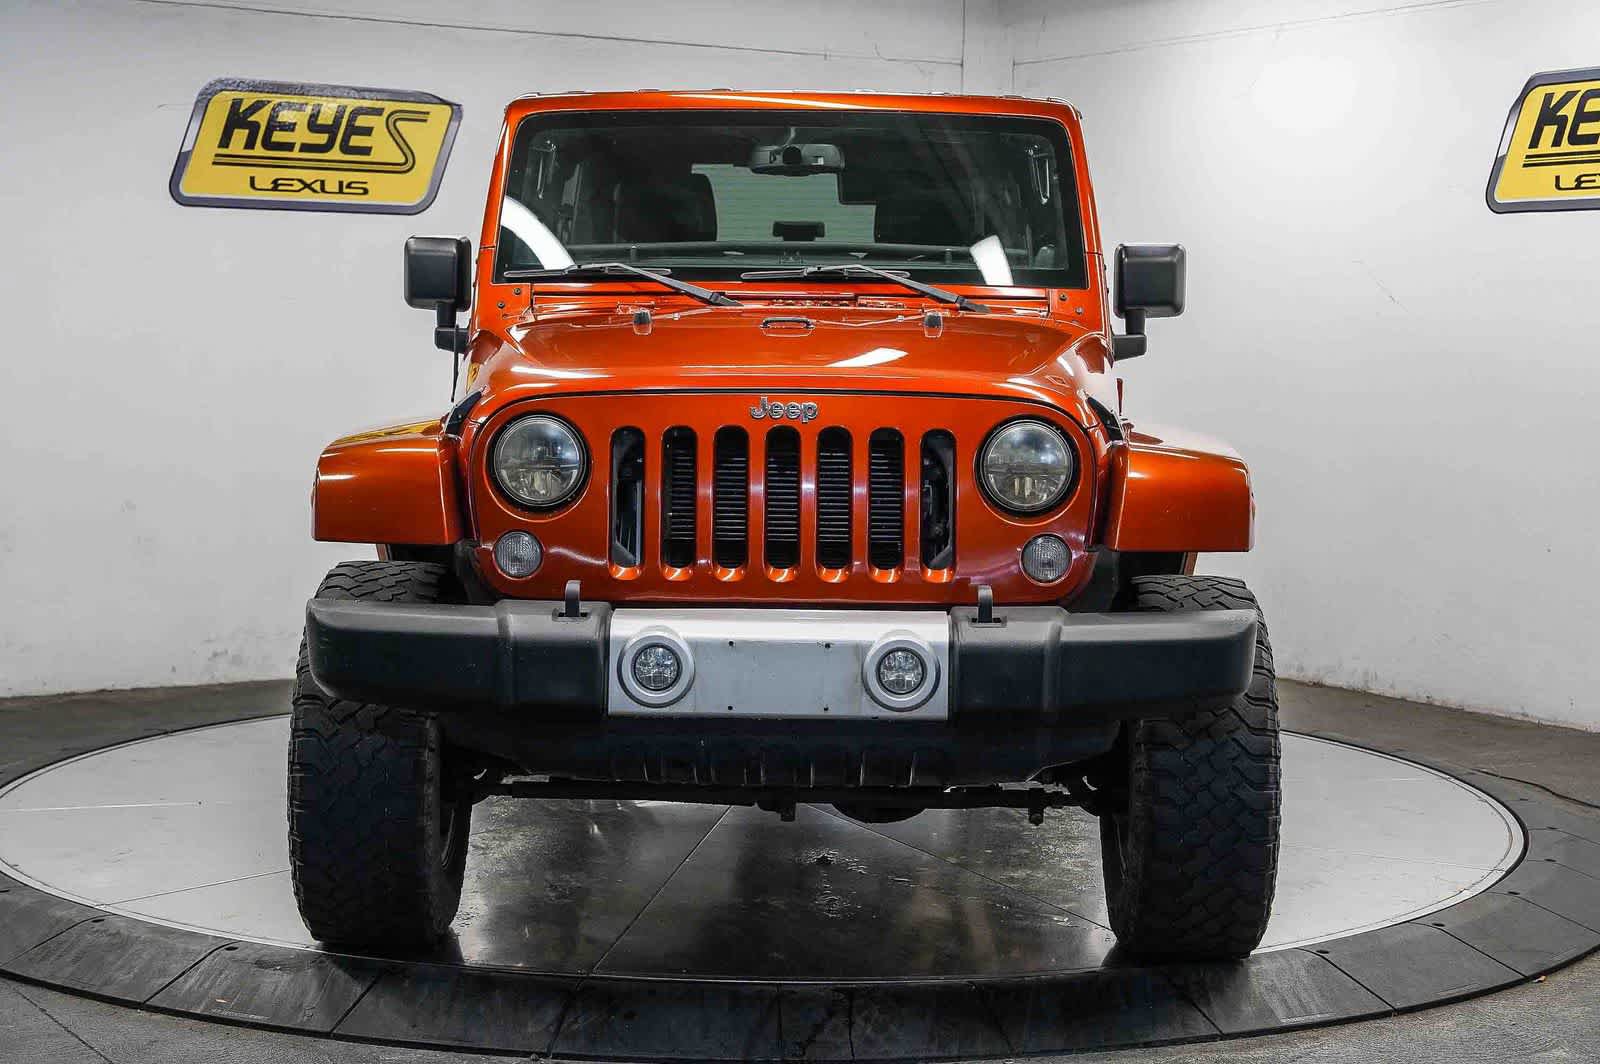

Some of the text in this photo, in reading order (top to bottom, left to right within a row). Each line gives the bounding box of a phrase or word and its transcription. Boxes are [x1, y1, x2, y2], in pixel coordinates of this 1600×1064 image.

[1528, 88, 1600, 149] KE
[214, 98, 430, 173] KEYES
[249, 175, 369, 196] LEXUS
[1554, 173, 1600, 191] LE
[749, 395, 818, 424] Jeep
